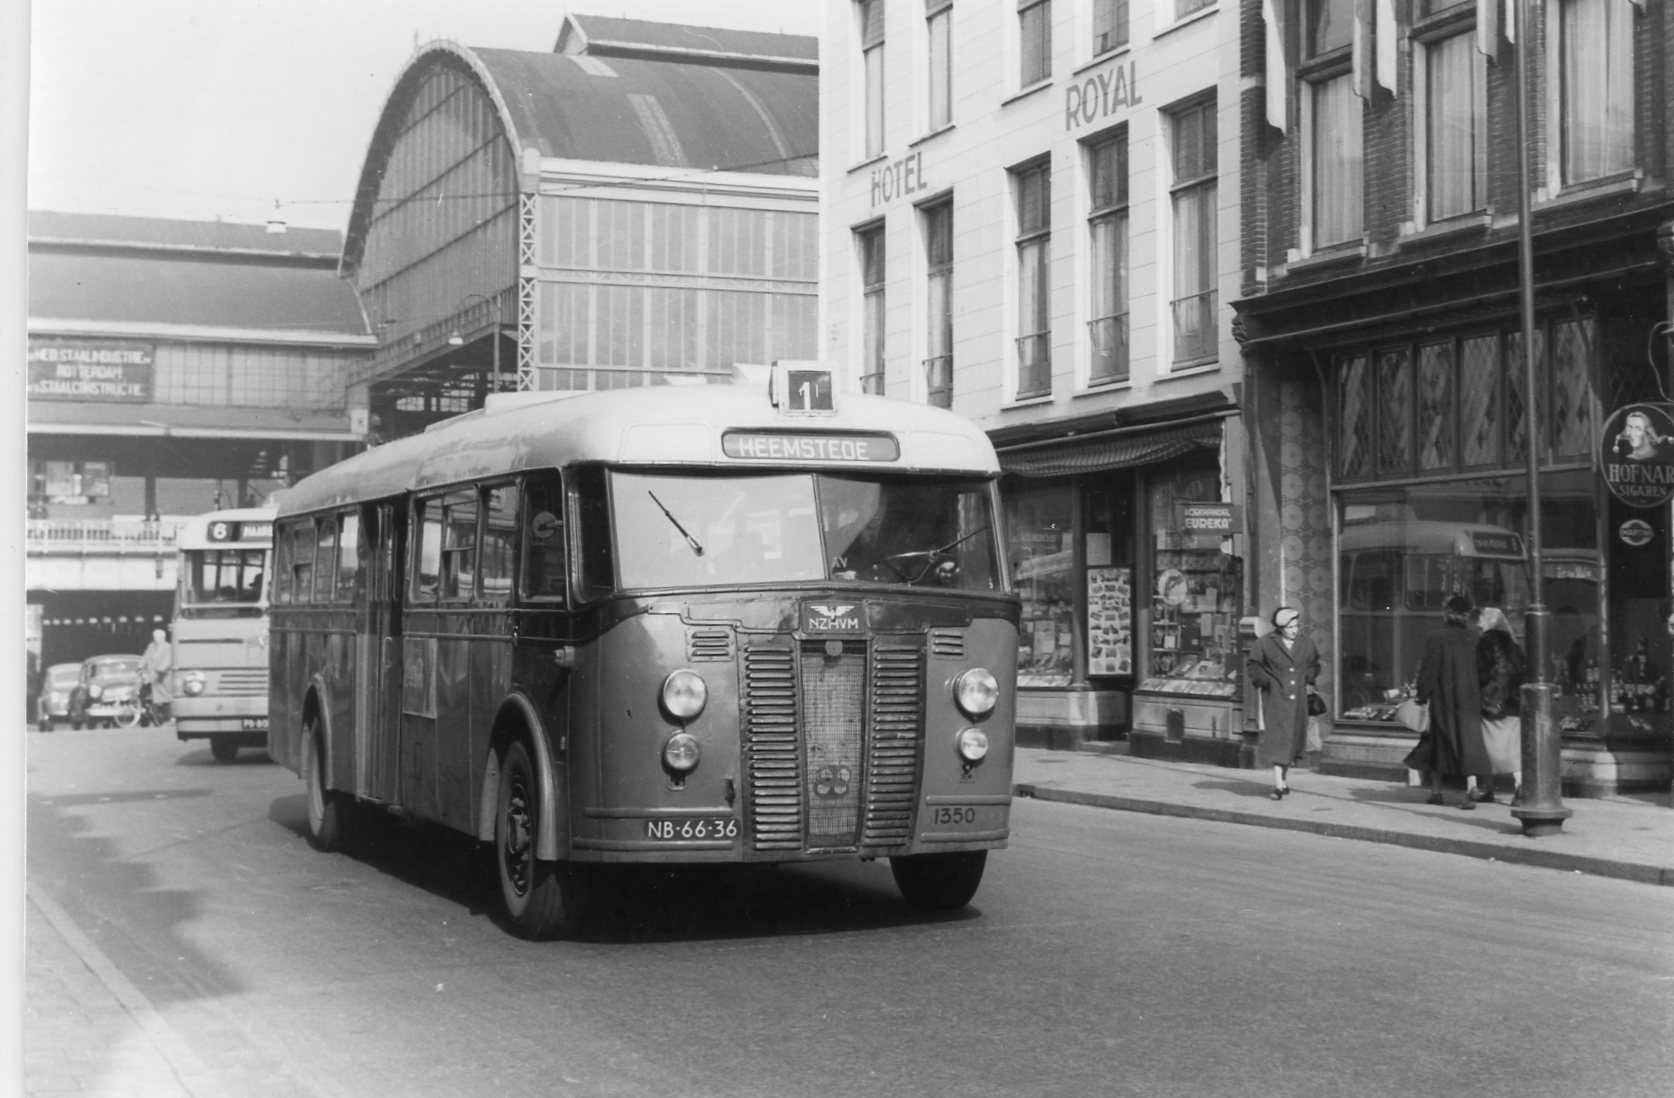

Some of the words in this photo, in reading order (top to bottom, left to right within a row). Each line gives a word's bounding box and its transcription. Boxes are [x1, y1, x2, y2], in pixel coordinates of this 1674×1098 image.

[871, 151, 927, 208] HOTEL
[1066, 60, 1142, 131] ROYAL
[738, 437, 870, 460] HEEMSTEDE
[1608, 464, 1674, 484] HOFNAR
[1618, 485, 1667, 497] SIGAREN
[213, 522, 227, 540] 6
[809, 618, 859, 630] NZHVM
[934, 807, 976, 825] 1350
[648, 820, 737, 838] NB-66-36
